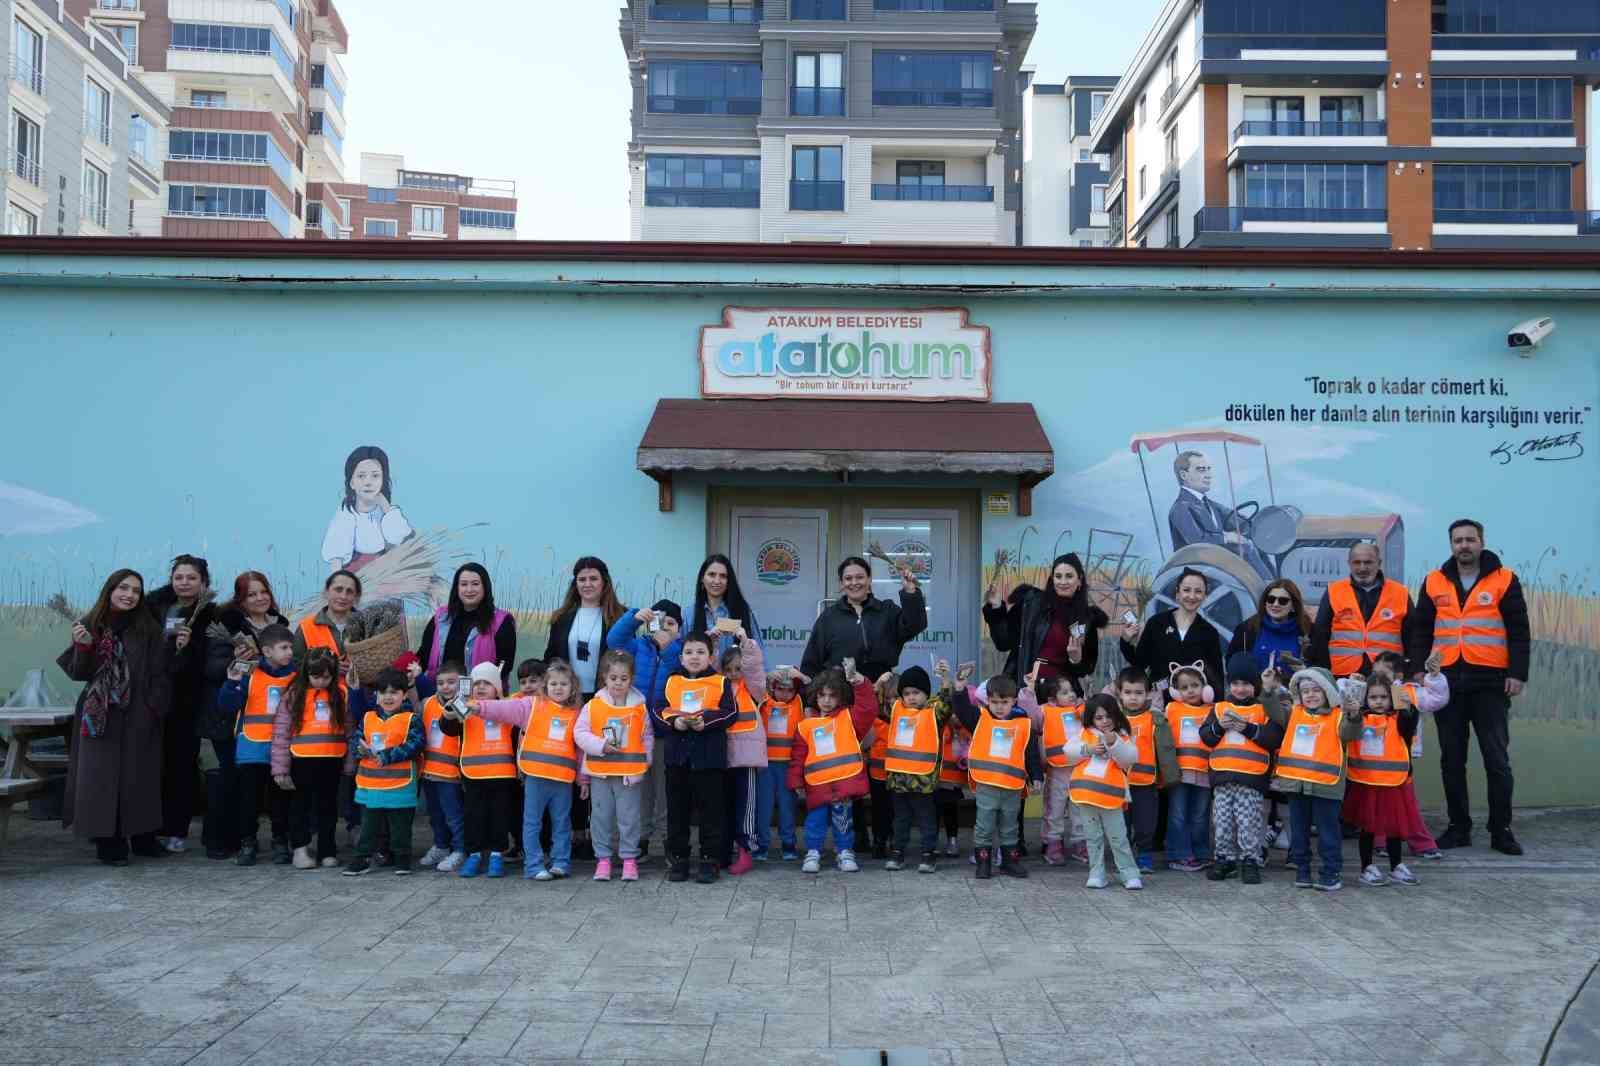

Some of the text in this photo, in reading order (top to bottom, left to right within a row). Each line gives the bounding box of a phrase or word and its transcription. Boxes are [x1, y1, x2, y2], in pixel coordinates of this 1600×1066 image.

[768, 316, 832, 328] ATAKUM
[1367, 381, 1376, 394] o
[1381, 377, 1426, 395] kadar
[1431, 378, 1485, 395] cömert
[1225, 404, 1285, 422] dökülen
[1291, 404, 1316, 422] her
[1321, 404, 1368, 422] damla
[1372, 405, 1400, 423] alın
[1405, 406, 1455, 423] terinin
[1461, 406, 1539, 429] karşılığını
